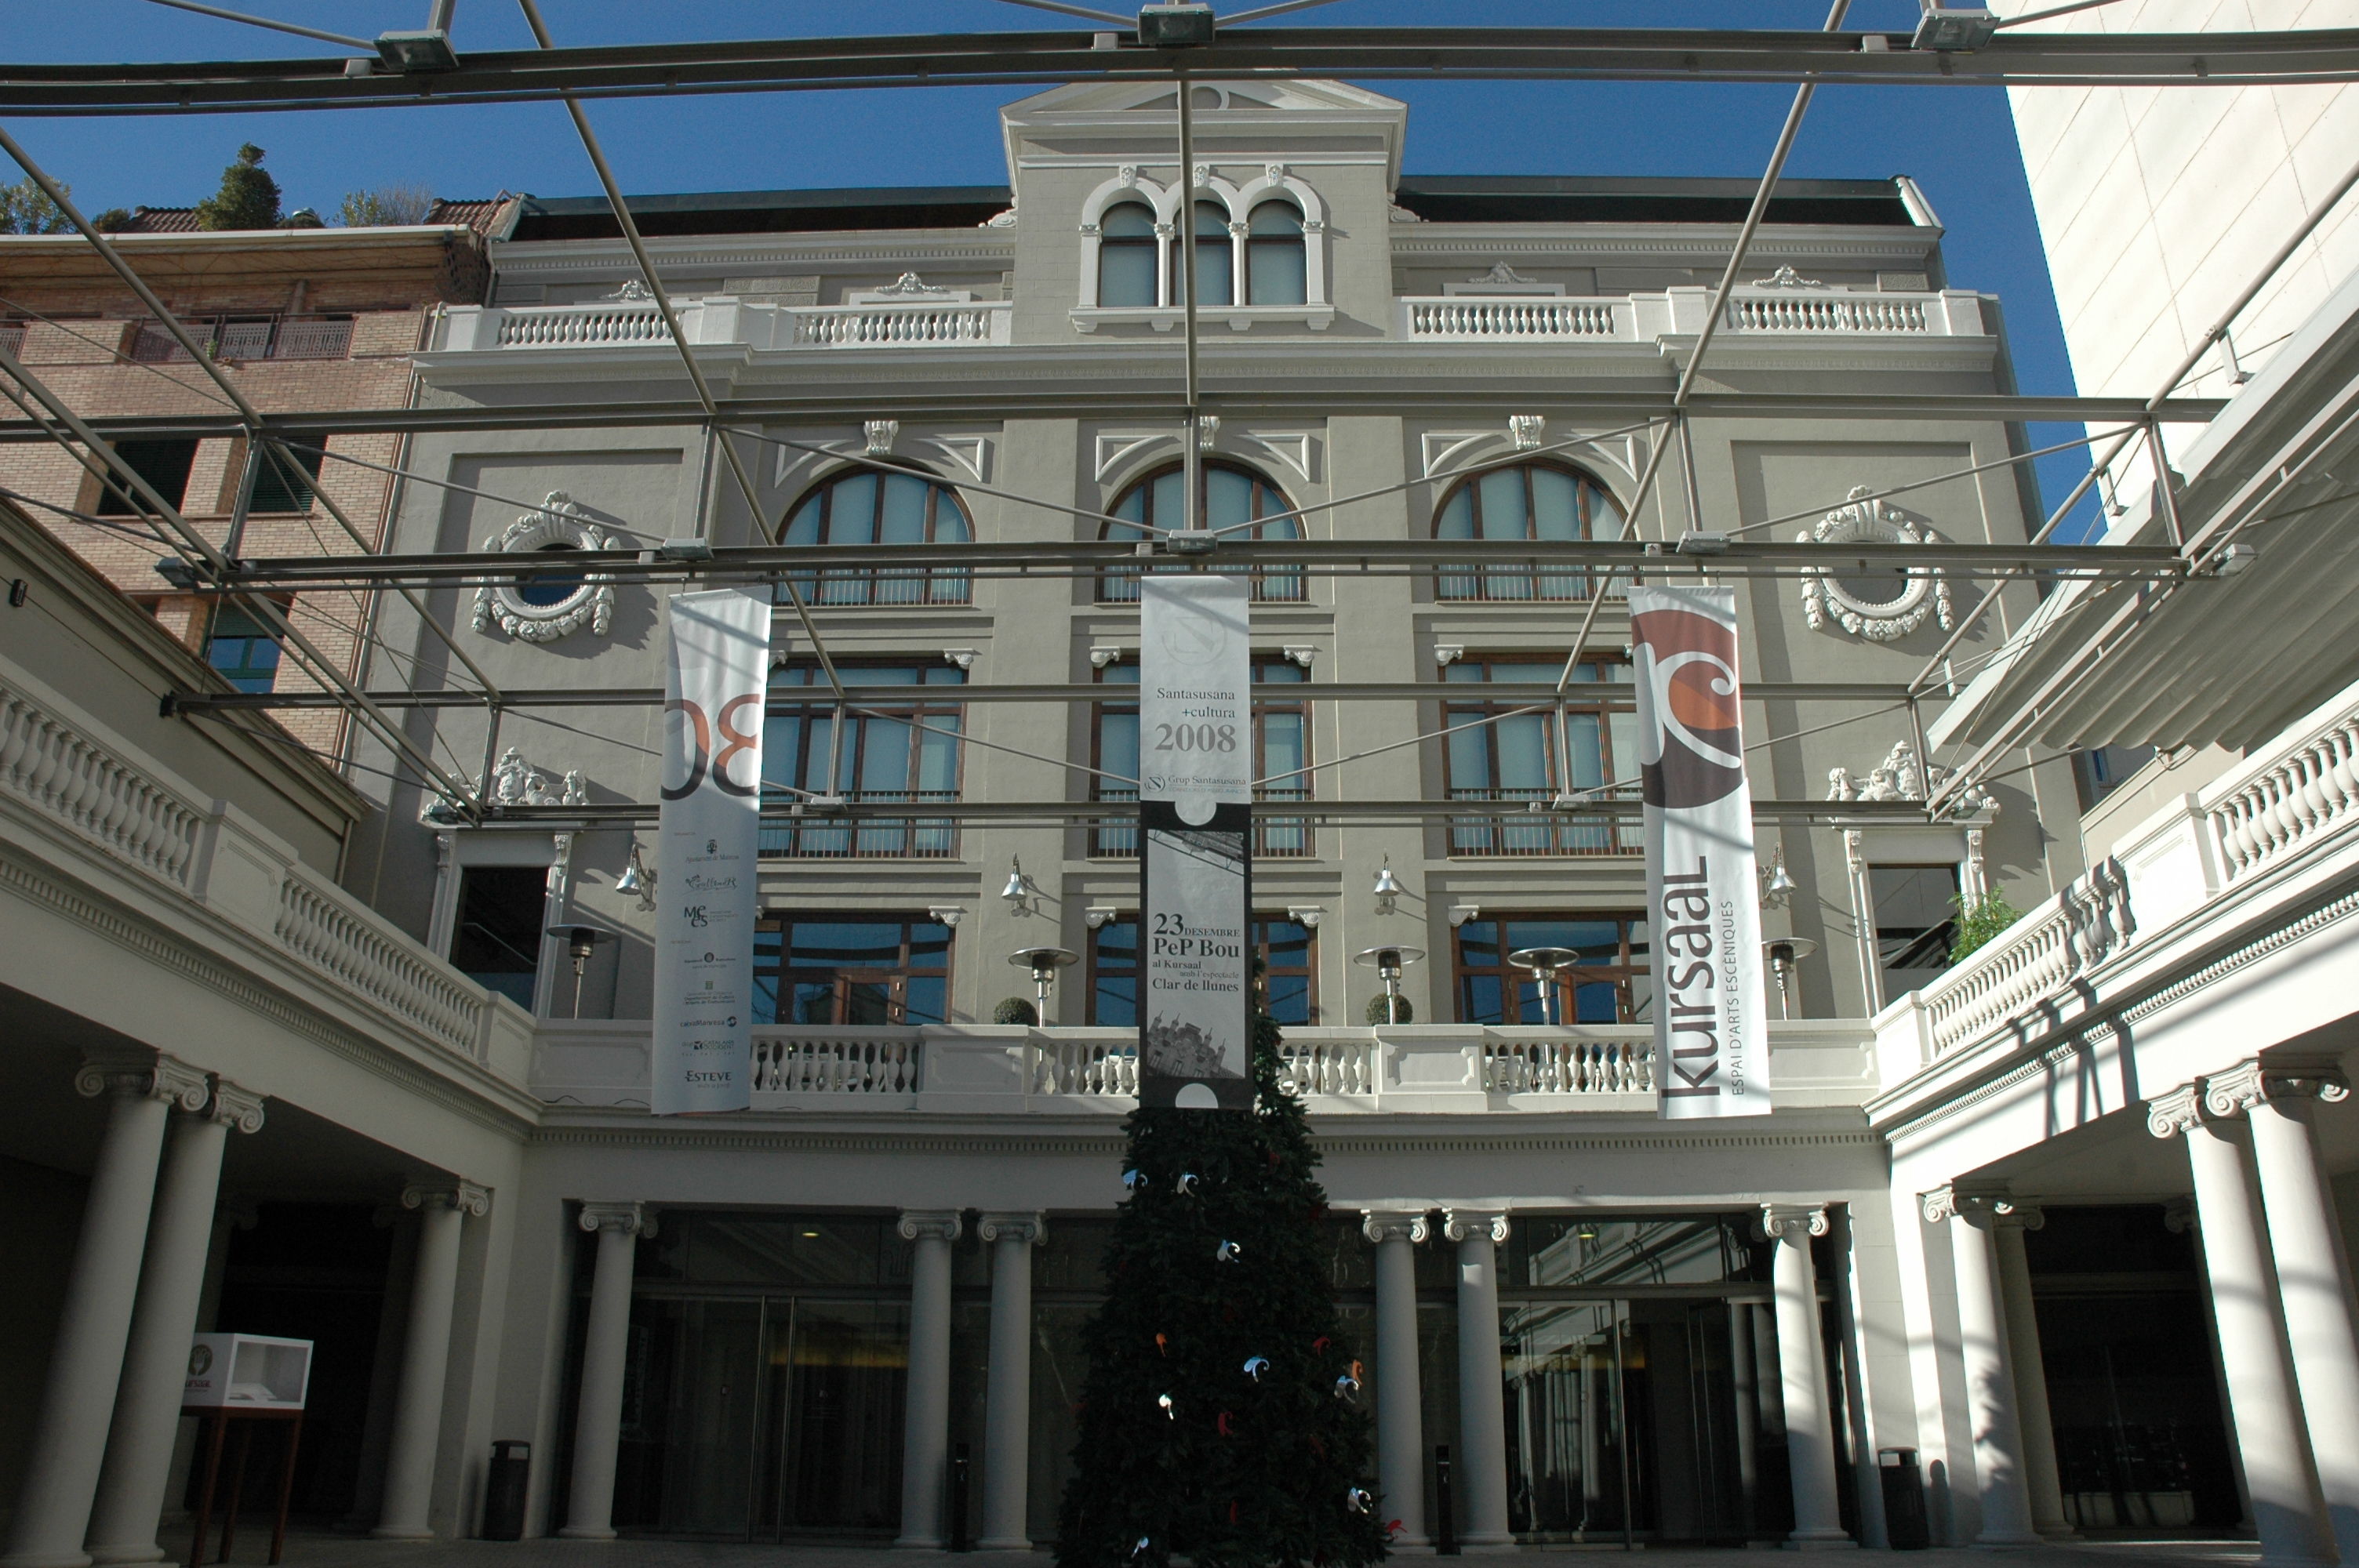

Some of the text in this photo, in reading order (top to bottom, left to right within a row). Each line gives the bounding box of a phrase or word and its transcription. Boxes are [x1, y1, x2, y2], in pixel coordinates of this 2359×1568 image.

[1157, 688, 1235, 700] Santasusana
[1182, 706, 1235, 718] +cultura
[1154, 723, 1236, 753] 2008
[1168, 775, 1246, 786] Grup Santasusana
[1153, 913, 1241, 937] 23 DESEMBRE
[1153, 937, 1241, 957] PeP Bou
[1152, 959, 1201, 969] al Kursaal
[1152, 978, 1239, 992] Clar de llunes
[1721, 900, 1744, 1095] ESPAI D'ARTS ESCÈNIQUES
[684, 1070, 732, 1083] ESTEVE
